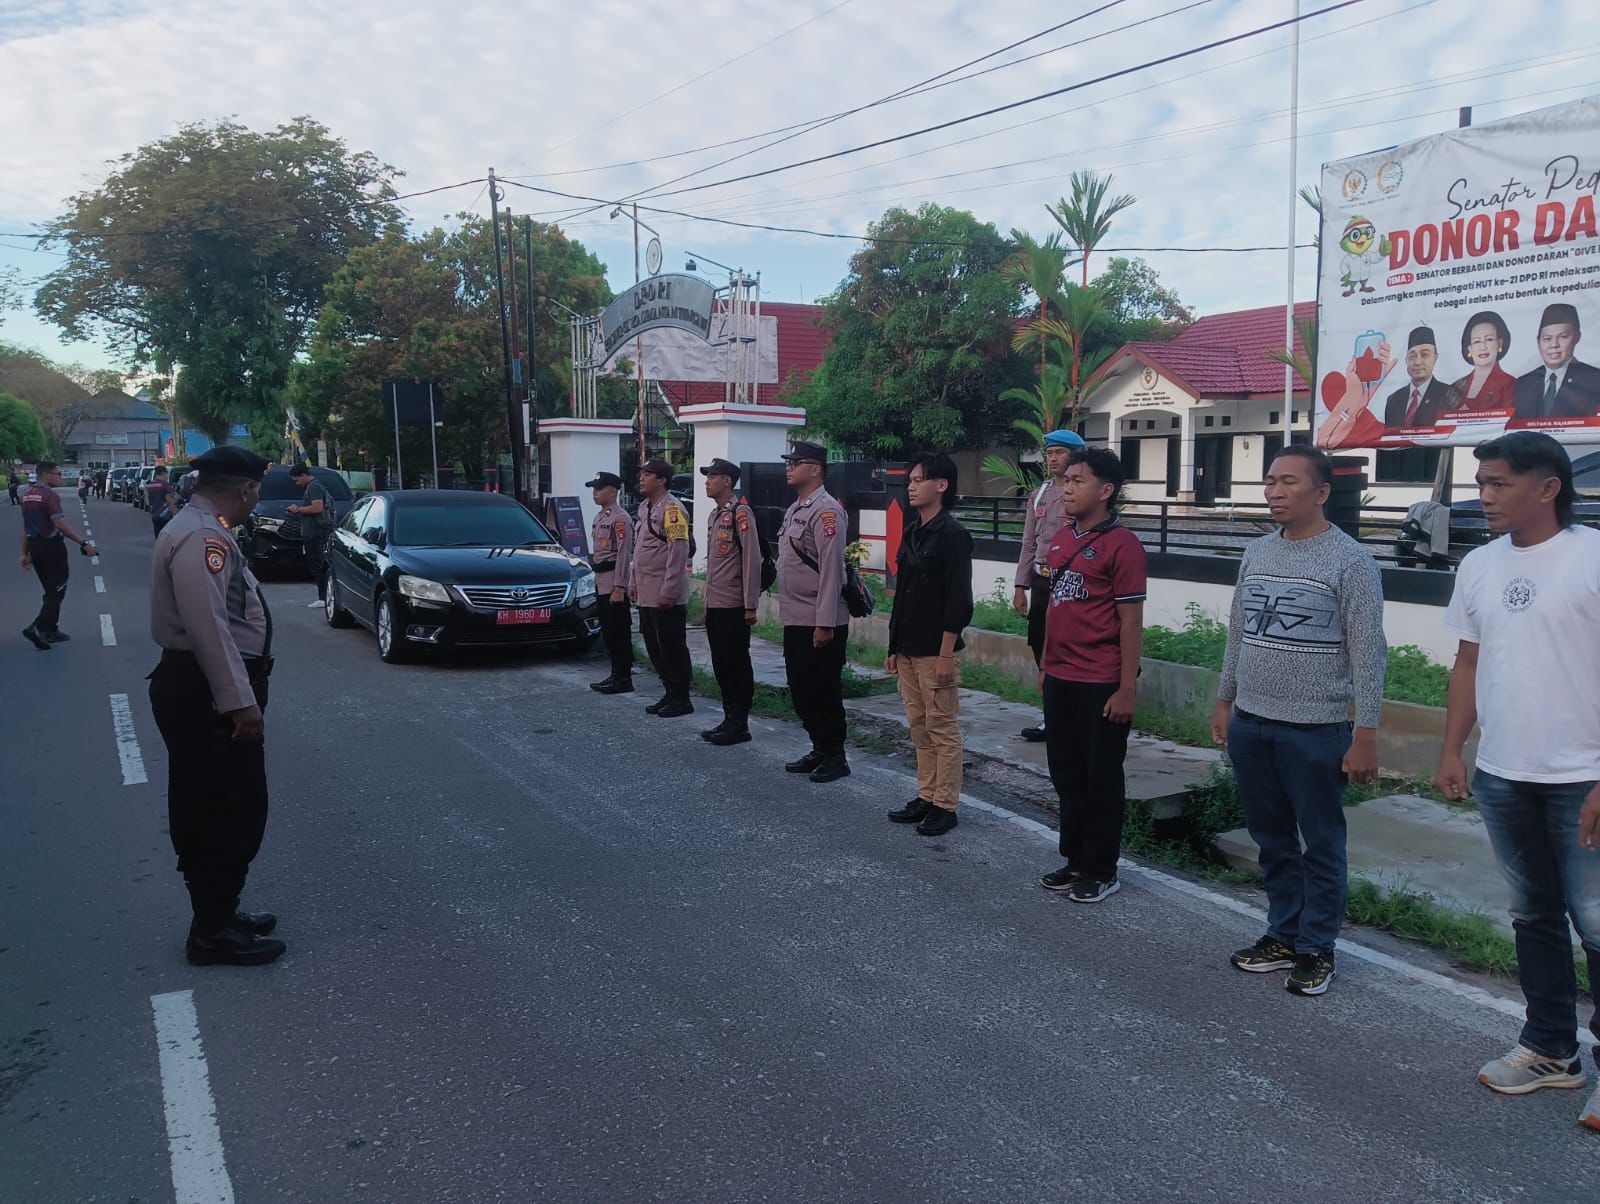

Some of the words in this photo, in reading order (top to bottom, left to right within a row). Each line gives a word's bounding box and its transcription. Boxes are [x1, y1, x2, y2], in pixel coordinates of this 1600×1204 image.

[1447, 177, 1537, 220] Senator
[1388, 209, 1520, 270] DONOR
[1534, 194, 1599, 247] DA
[1415, 268, 1451, 281] SENATOR
[1451, 263, 1485, 275] BERBAGI
[1486, 260, 1504, 270] DAN
[1505, 254, 1536, 267] DONOR
[1536, 249, 1569, 262] DARAH
[1414, 281, 1475, 297] memperingati
[1475, 279, 1493, 289] HUT
[1519, 272, 1538, 283] DPD
[1539, 270, 1548, 280] RI
[1434, 296, 1467, 309] sebagai
[1468, 294, 1493, 304] salah
[1494, 290, 1514, 301] satu
[1515, 286, 1548, 298] bentuk
[497, 609, 509, 619] KH
[514, 608, 535, 619] 1960
